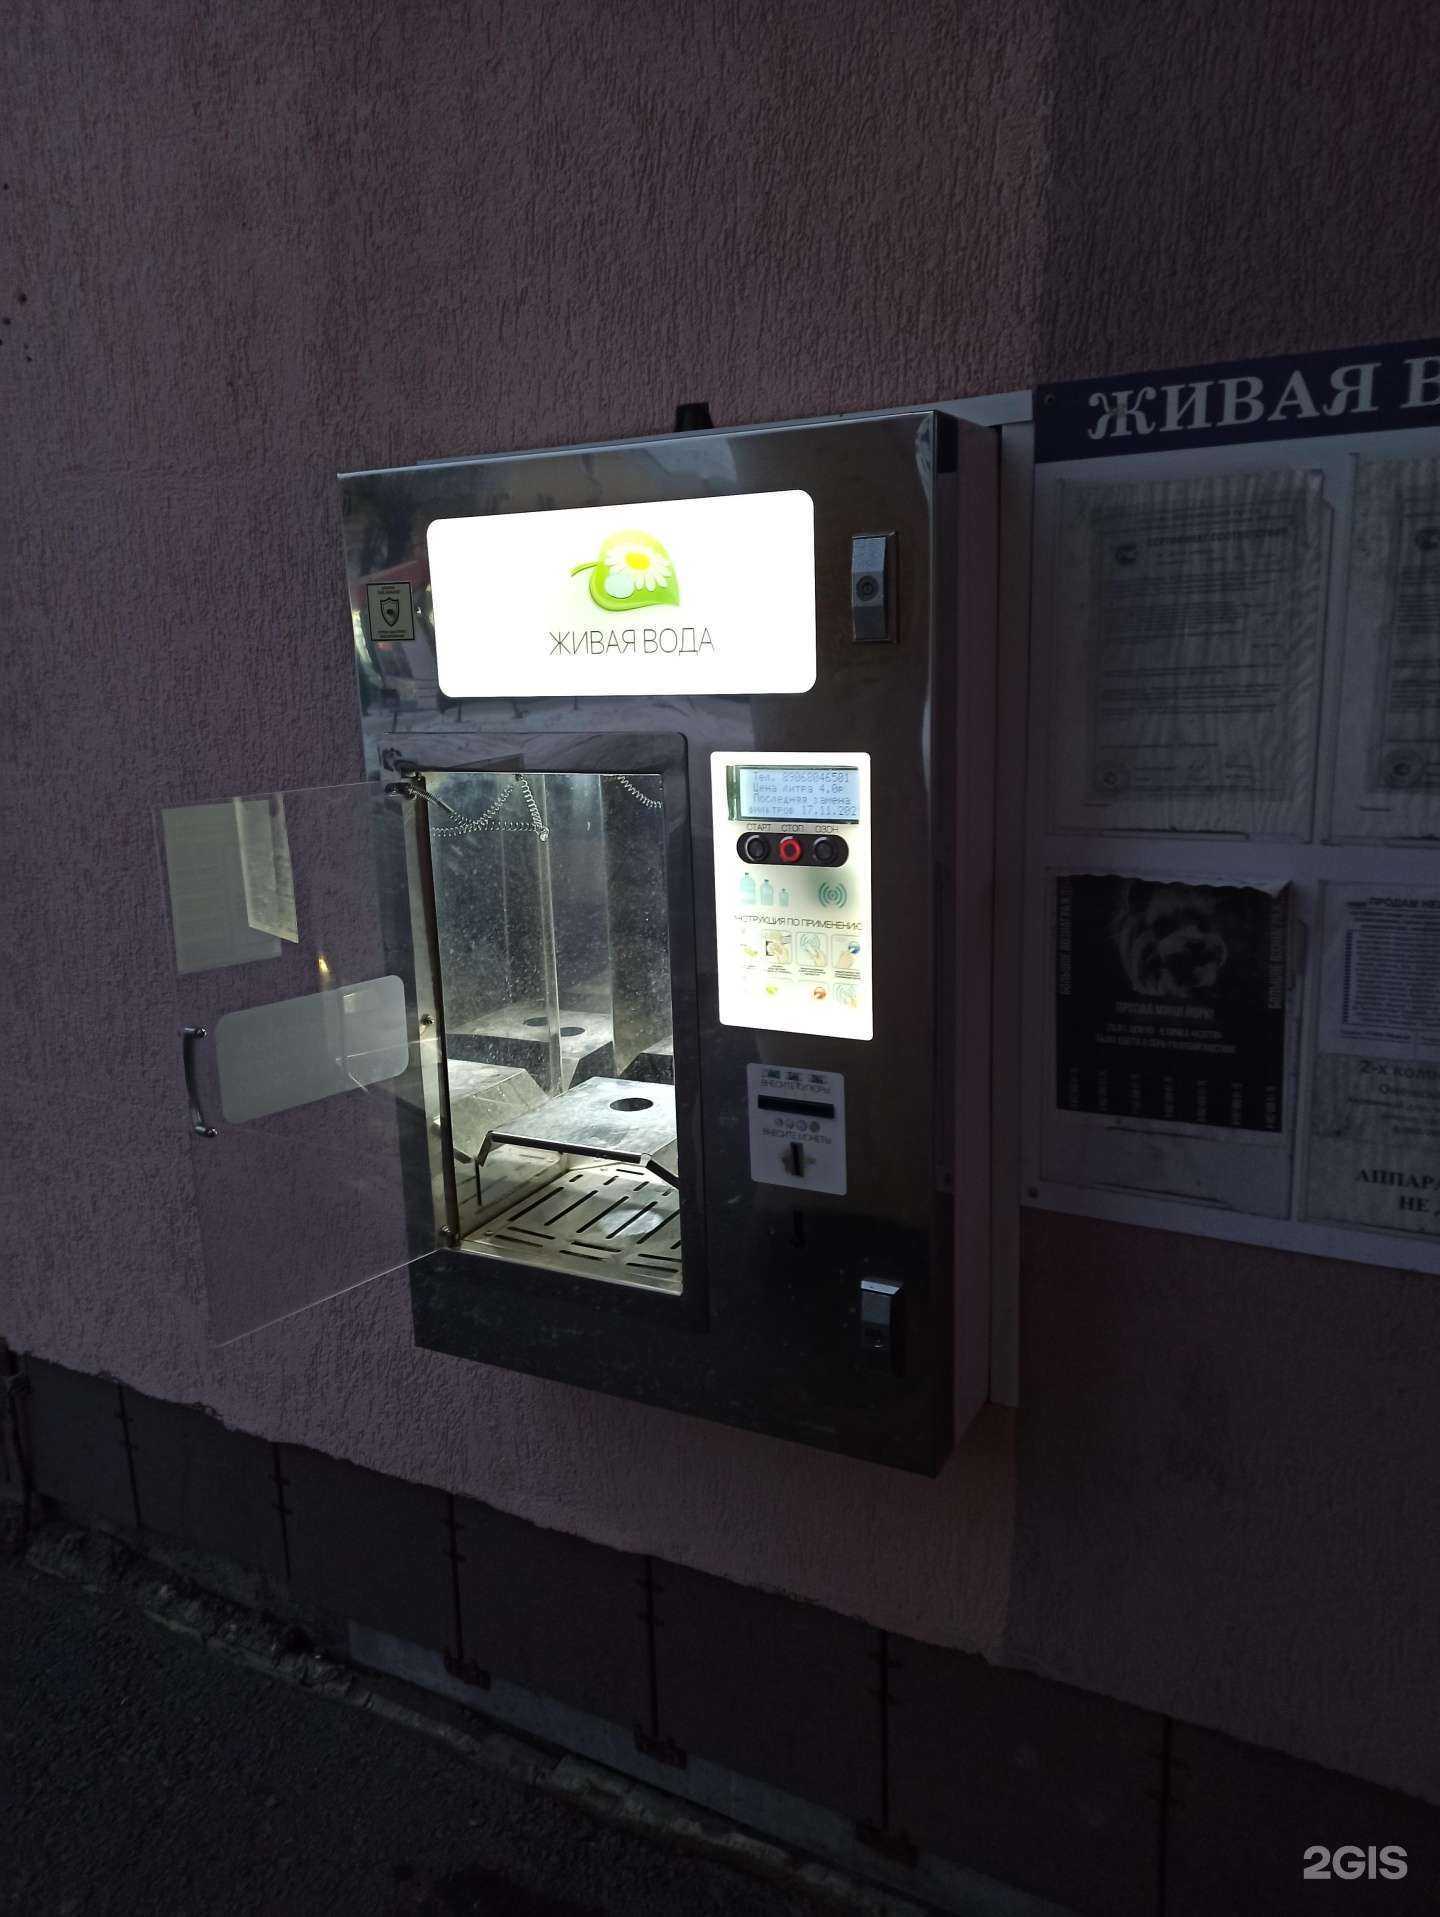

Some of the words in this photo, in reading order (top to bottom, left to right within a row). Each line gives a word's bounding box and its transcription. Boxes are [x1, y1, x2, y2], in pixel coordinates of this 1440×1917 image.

[1087, 362, 1382, 441] ЖИВАЯ
[549, 629, 636, 655] ЖИВАЯ
[643, 627, 715, 656] ВОДА
[753, 783, 777, 793] Цена
[783, 784, 815, 793] литра
[747, 823, 772, 832] СТАРТ
[781, 824, 805, 833] СТОП
[815, 825, 839, 833] ОЗОН
[787, 917, 800, 927] ПО
[1399, 1195, 1429, 1213] НЕ
